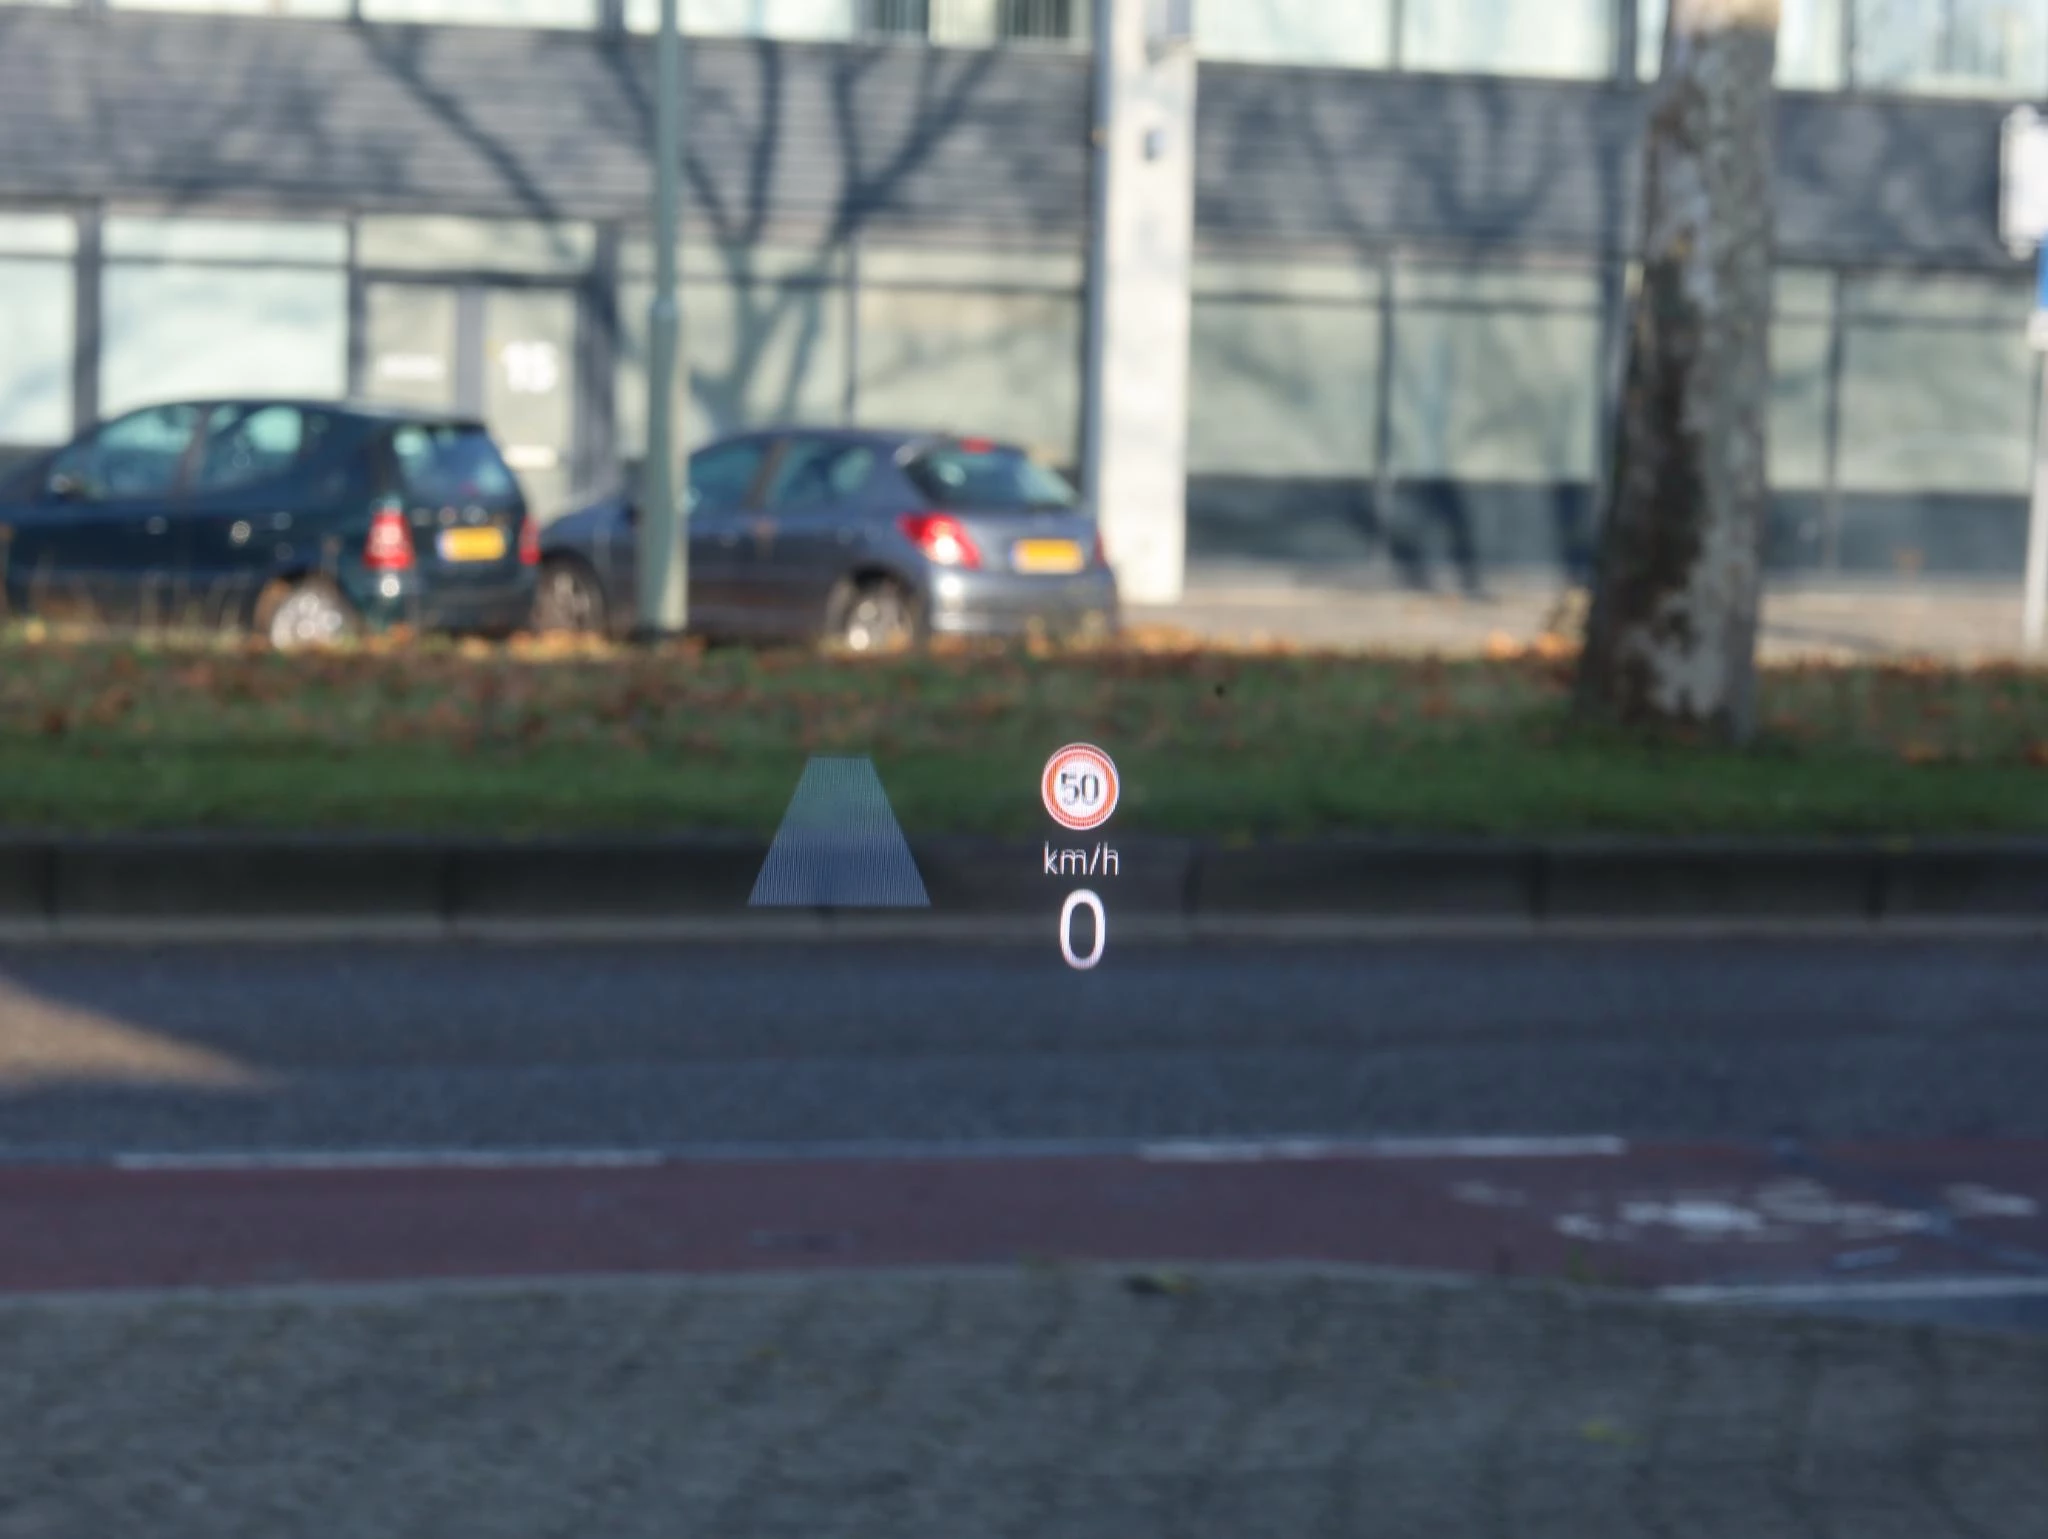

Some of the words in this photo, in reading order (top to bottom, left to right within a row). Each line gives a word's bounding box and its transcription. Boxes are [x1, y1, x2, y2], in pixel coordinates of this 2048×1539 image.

[1061, 773, 1099, 806] 50
[1044, 841, 1119, 875] km/h
[1060, 889, 1105, 969] 0
